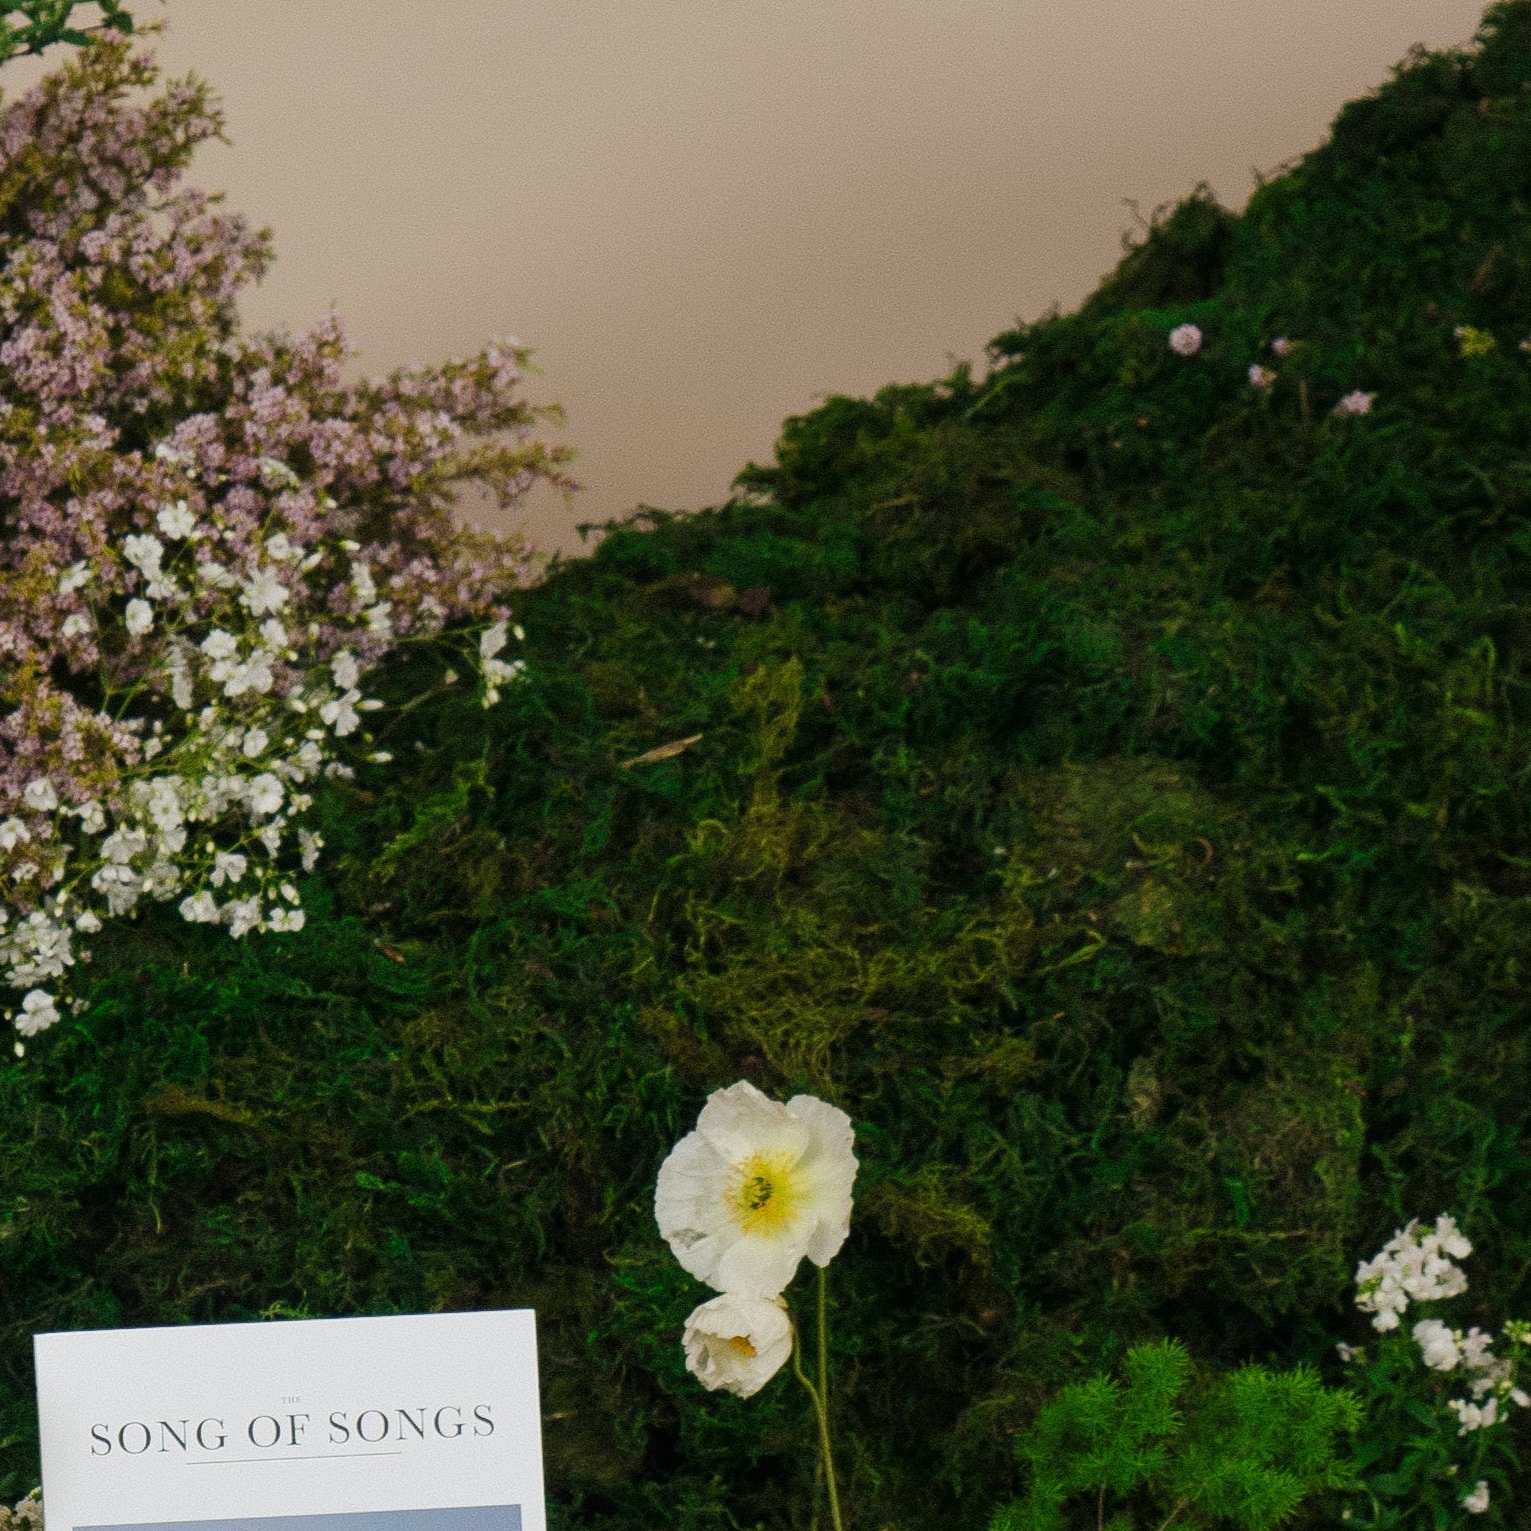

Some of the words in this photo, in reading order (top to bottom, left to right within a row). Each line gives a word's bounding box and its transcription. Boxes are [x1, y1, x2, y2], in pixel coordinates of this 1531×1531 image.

[90, 1417, 228, 1456] SONG
[247, 1413, 311, 1448] OF
[328, 1404, 496, 1445] SONGS
